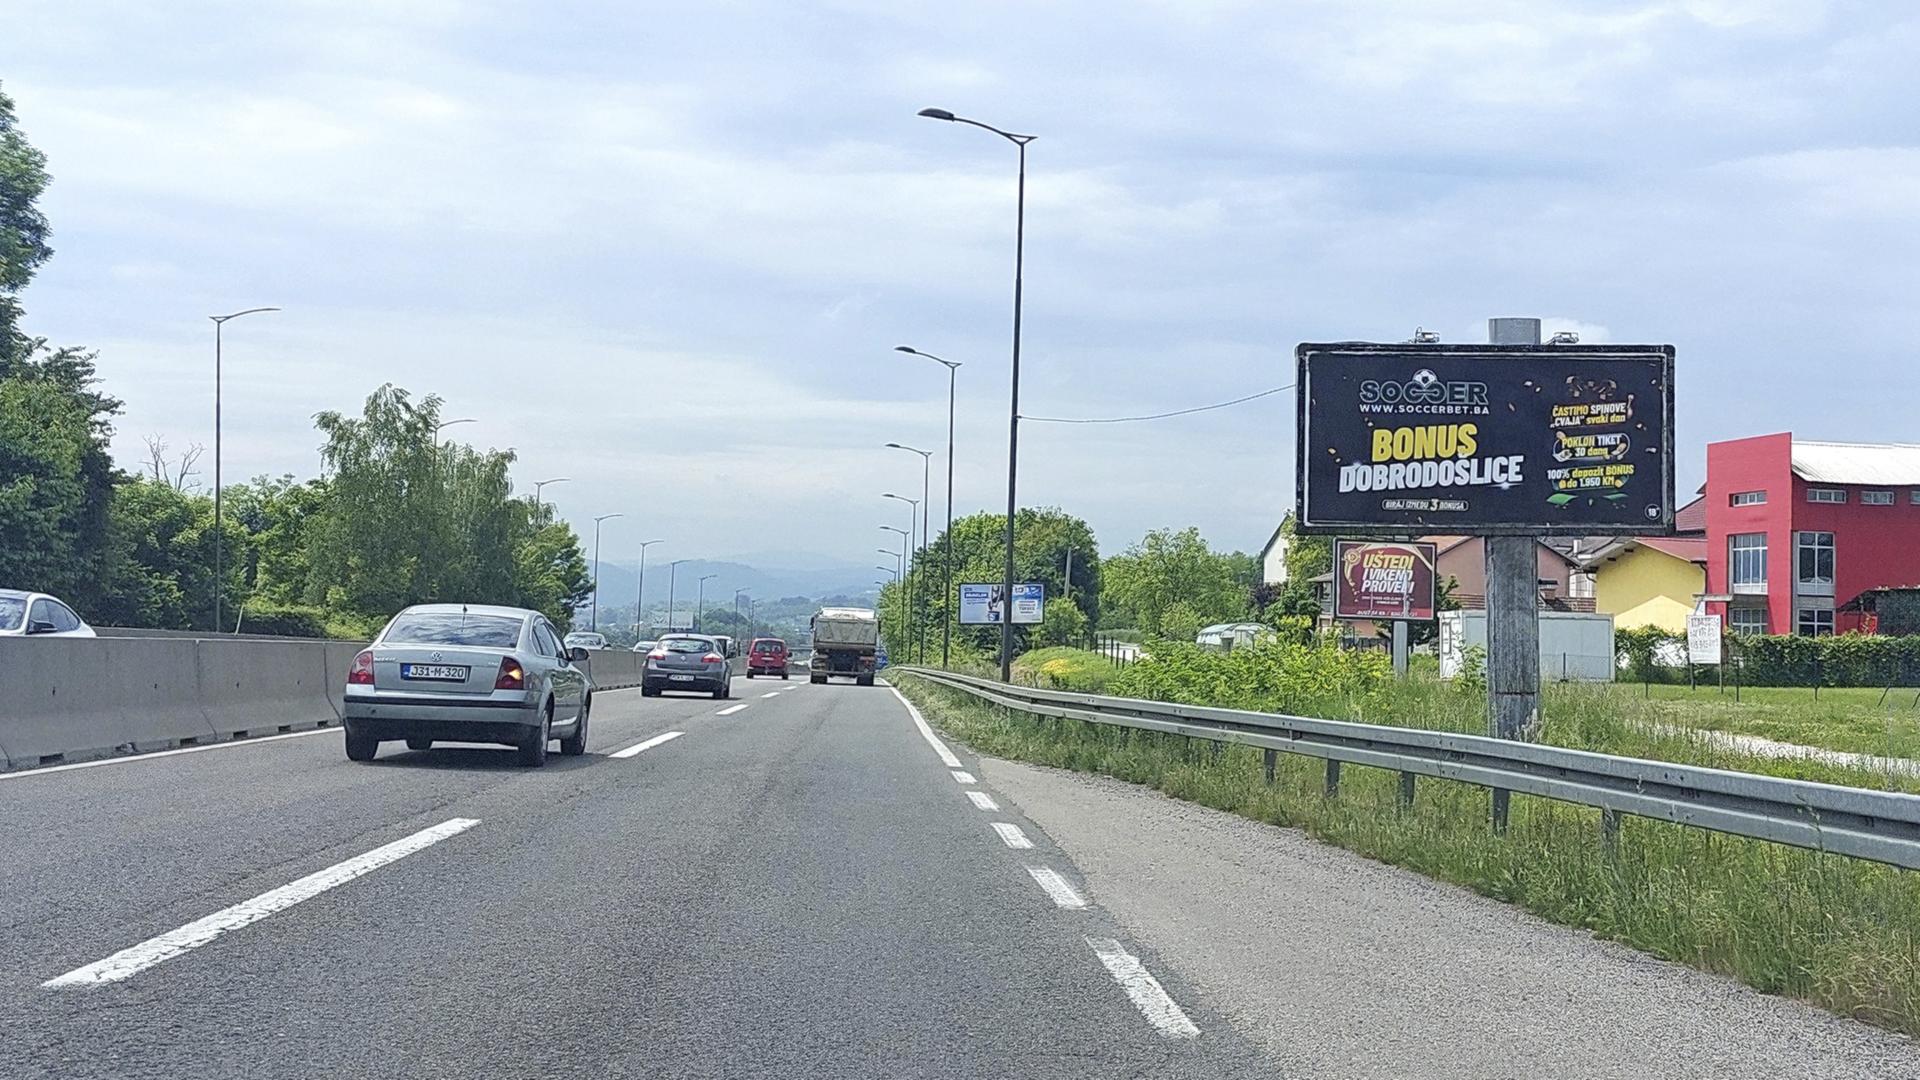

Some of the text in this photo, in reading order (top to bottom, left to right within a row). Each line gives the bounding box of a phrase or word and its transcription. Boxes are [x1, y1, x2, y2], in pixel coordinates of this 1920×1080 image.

[1359, 380, 1489, 405] SOCCER
[1359, 404, 1490, 415] WWW.SOCCERBET.BA
[1552, 403, 1626, 417] ČASTIMO SPINOVE
[1586, 414, 1608, 424] svaki
[1610, 414, 1625, 422] dan
[1372, 423, 1477, 462] BONUS
[1562, 435, 1621, 448] POKLON TIKET
[1574, 447, 1586, 457] 30
[1547, 469, 1570, 479] 100%
[1605, 464, 1634, 475] BONUS
[1567, 479, 1577, 488] do
[1602, 476, 1614, 485] KM
[1429, 498, 1439, 512] 3
[1363, 551, 1415, 569] UŠTEDI
[1362, 568, 1369, 581] I
[411, 666, 465, 678] J31-M-320
